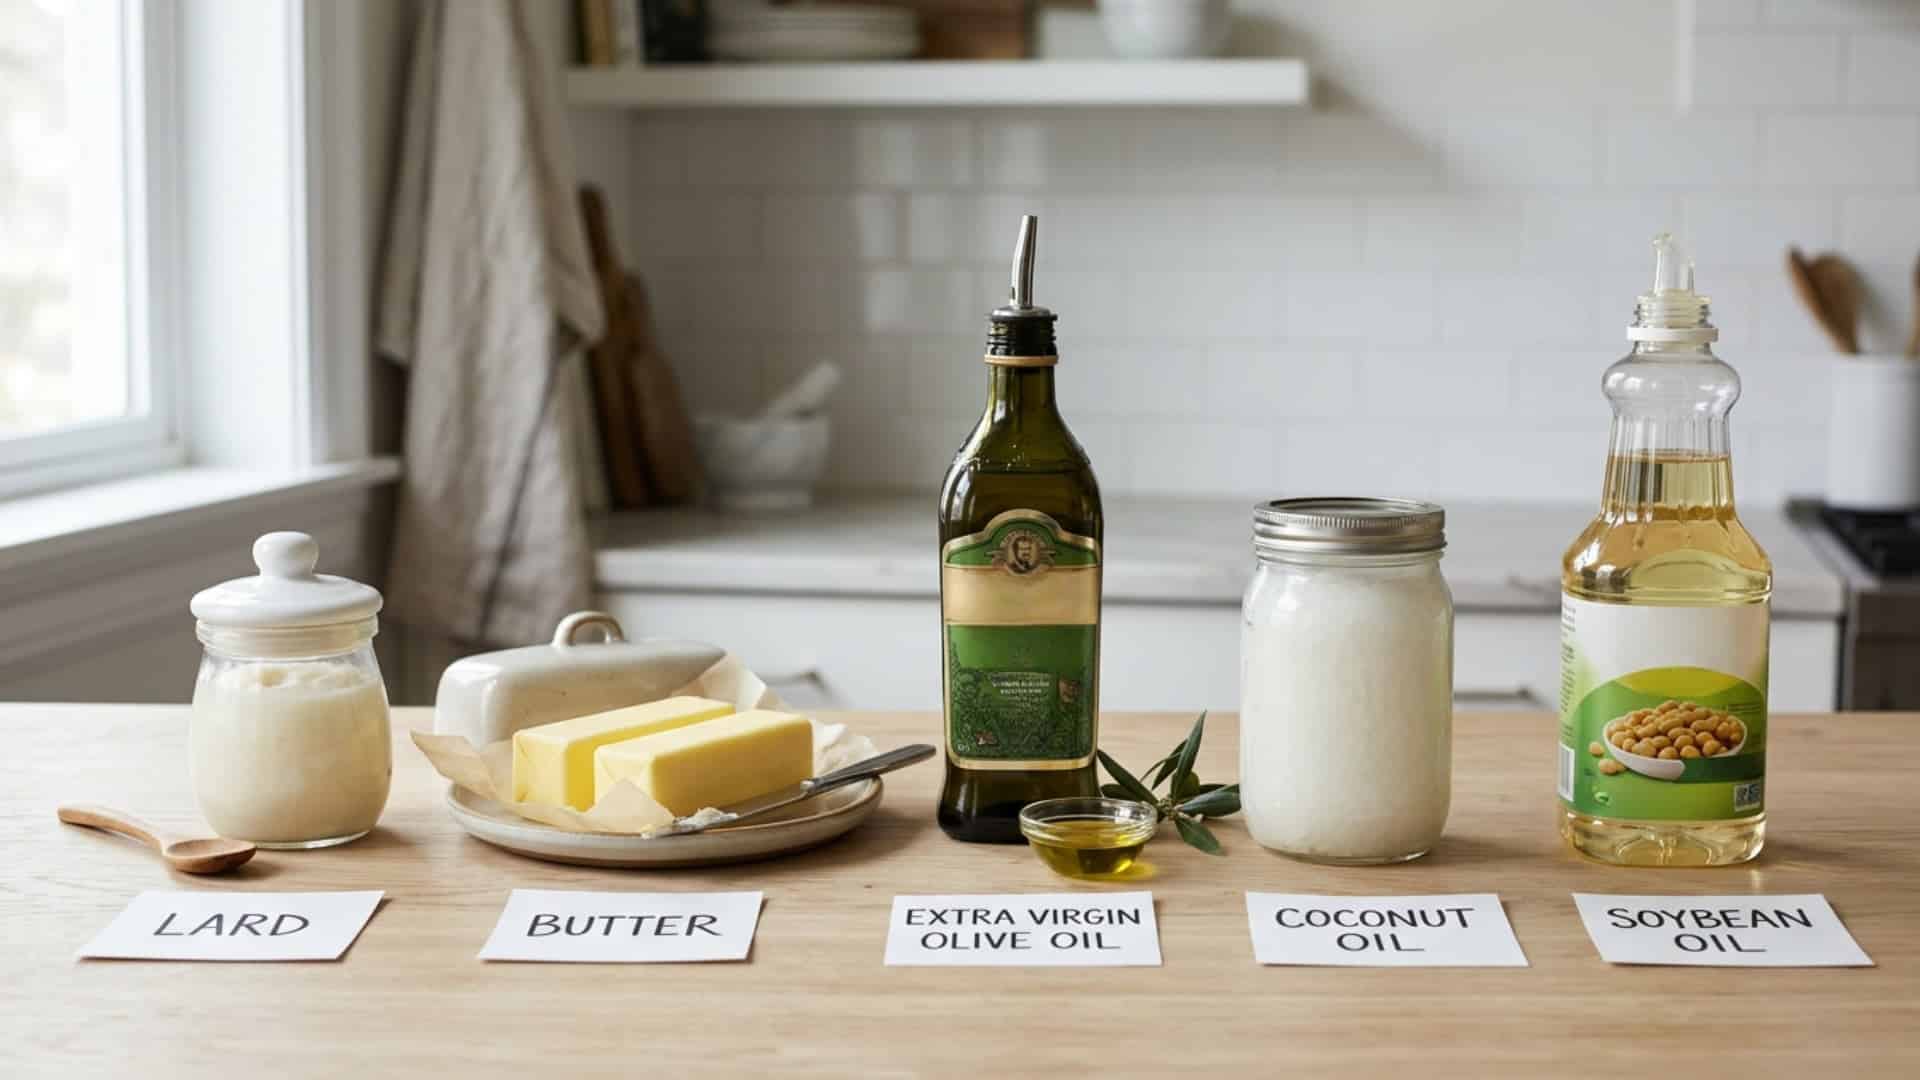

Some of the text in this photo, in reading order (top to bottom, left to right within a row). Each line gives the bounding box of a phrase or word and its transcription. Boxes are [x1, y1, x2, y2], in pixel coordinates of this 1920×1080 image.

[154, 912, 309, 938] LARD
[527, 913, 721, 937] BUTTER
[905, 908, 1140, 926] EXTRA VIRGIN
[1275, 907, 1474, 929] COCONUT
[1608, 908, 1812, 930] SOYBEAN
[920, 932, 1121, 950] OLIVE OIL
[1337, 933, 1425, 953] OIL
[1675, 933, 1766, 953] OIL
